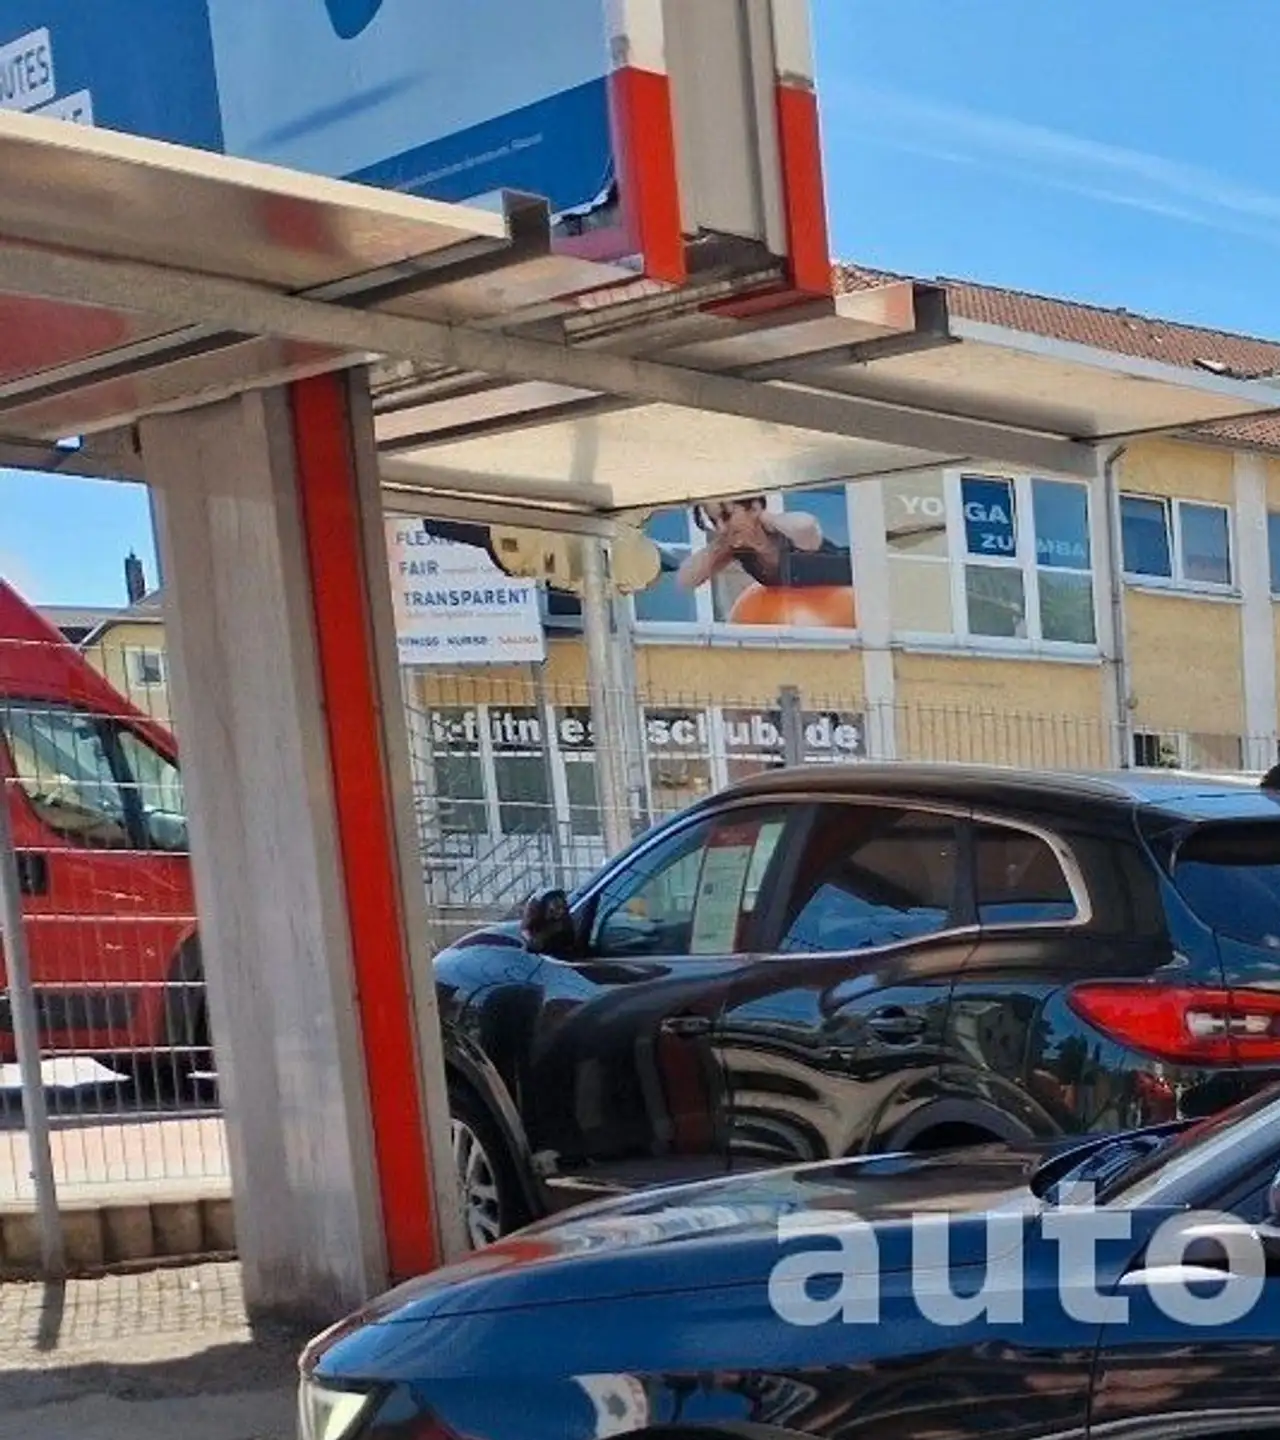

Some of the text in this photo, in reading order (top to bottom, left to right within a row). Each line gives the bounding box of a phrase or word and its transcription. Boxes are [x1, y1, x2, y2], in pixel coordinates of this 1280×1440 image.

[896, 494, 1009, 525] YOGA
[399, 560, 439, 576] FAIR
[404, 588, 529, 607] TRANSPARENT
